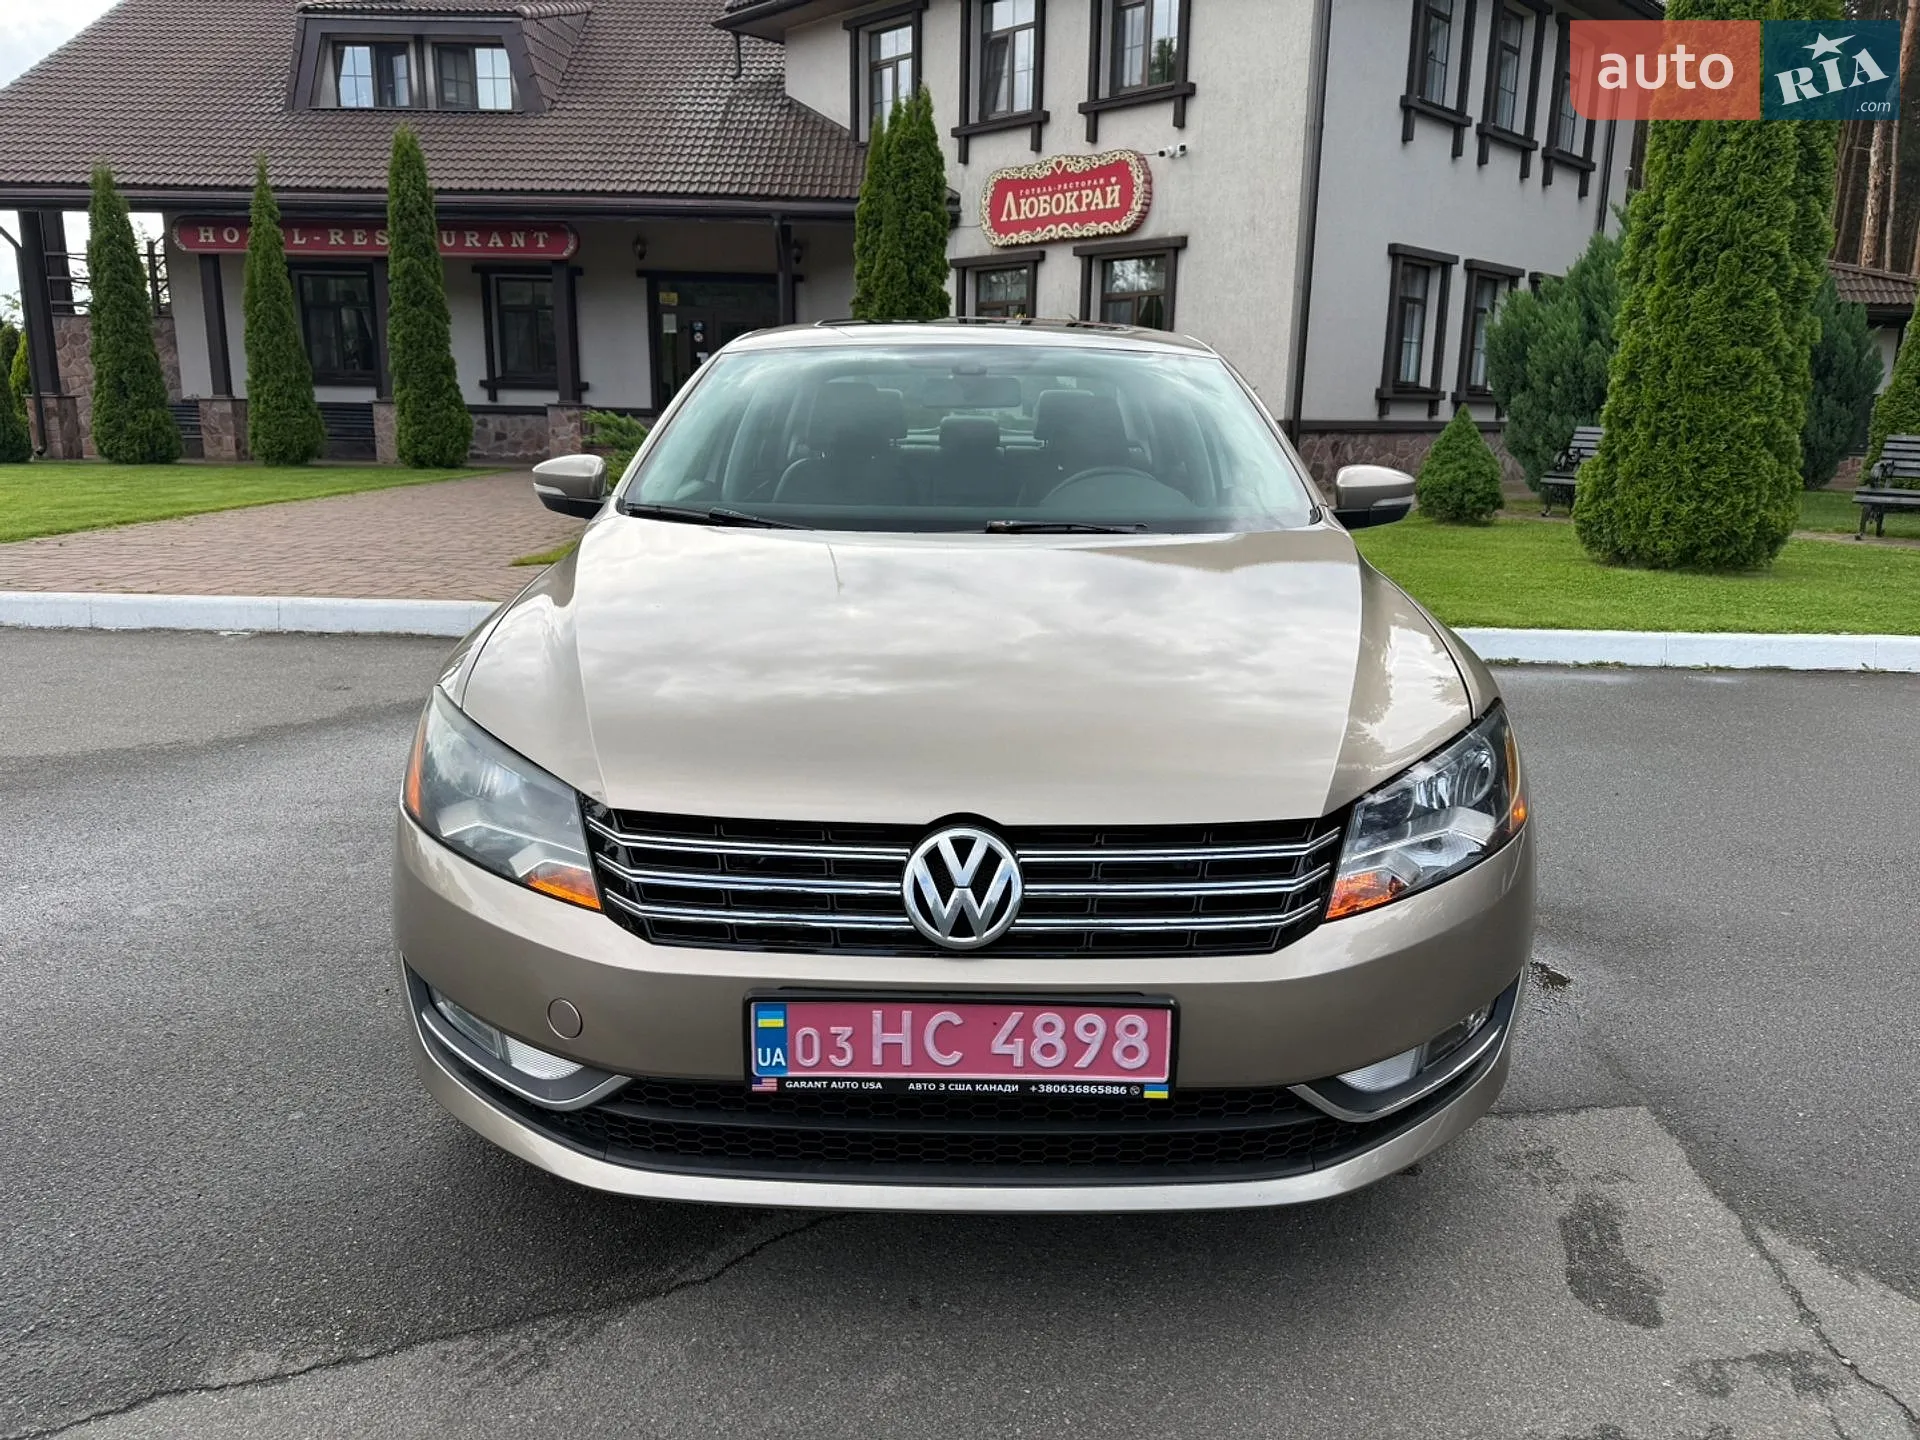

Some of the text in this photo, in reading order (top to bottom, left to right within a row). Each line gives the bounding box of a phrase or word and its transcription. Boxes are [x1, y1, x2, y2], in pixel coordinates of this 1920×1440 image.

[1000, 184, 1121, 222] ЛЮБОКРАЙ
[198, 226, 549, 248] HOL-RESURANT
[795, 1010, 1151, 1070] 03 HC 4898
[757, 1047, 787, 1067] UA
[785, 1080, 883, 1089] GARANT AUTO USA
[908, 1083, 936, 1091] АВТО
[948, 1083, 972, 1091] США
[975, 1083, 1019, 1093] КАНАДИ
